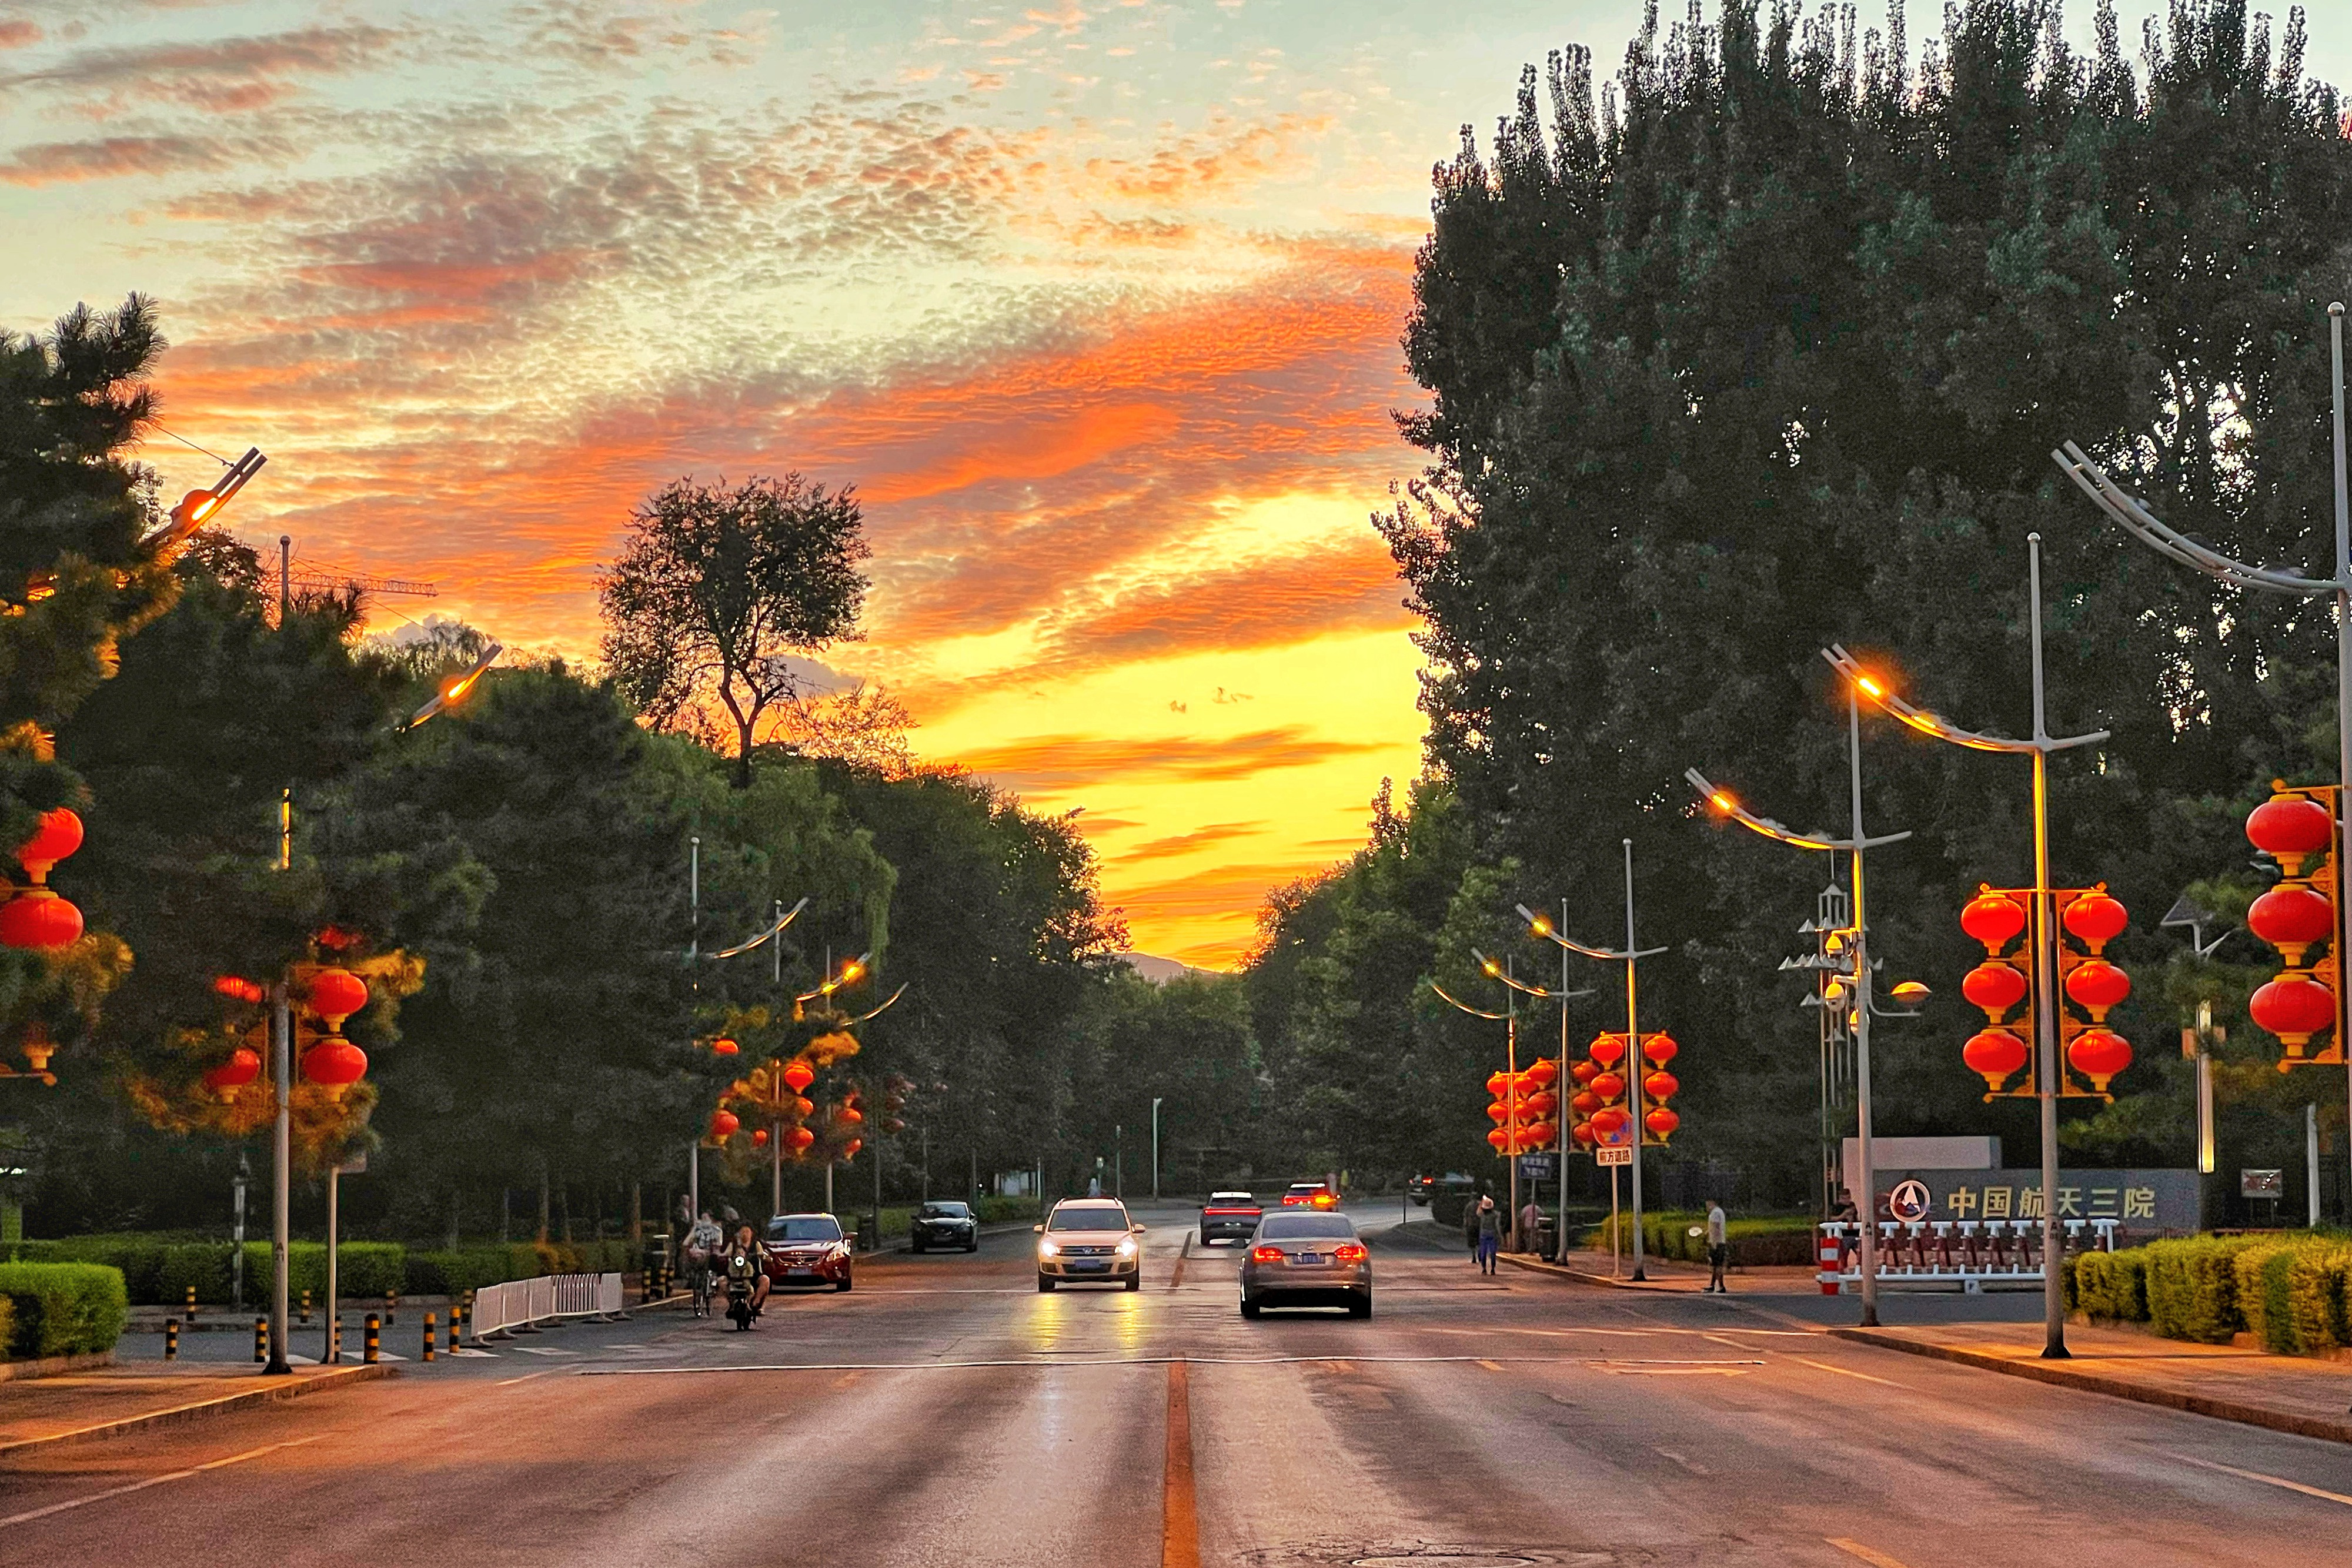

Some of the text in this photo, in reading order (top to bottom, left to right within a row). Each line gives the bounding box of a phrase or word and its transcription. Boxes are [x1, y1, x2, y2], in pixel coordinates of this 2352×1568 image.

[1948, 1186, 2156, 1218] 中国航天三院
